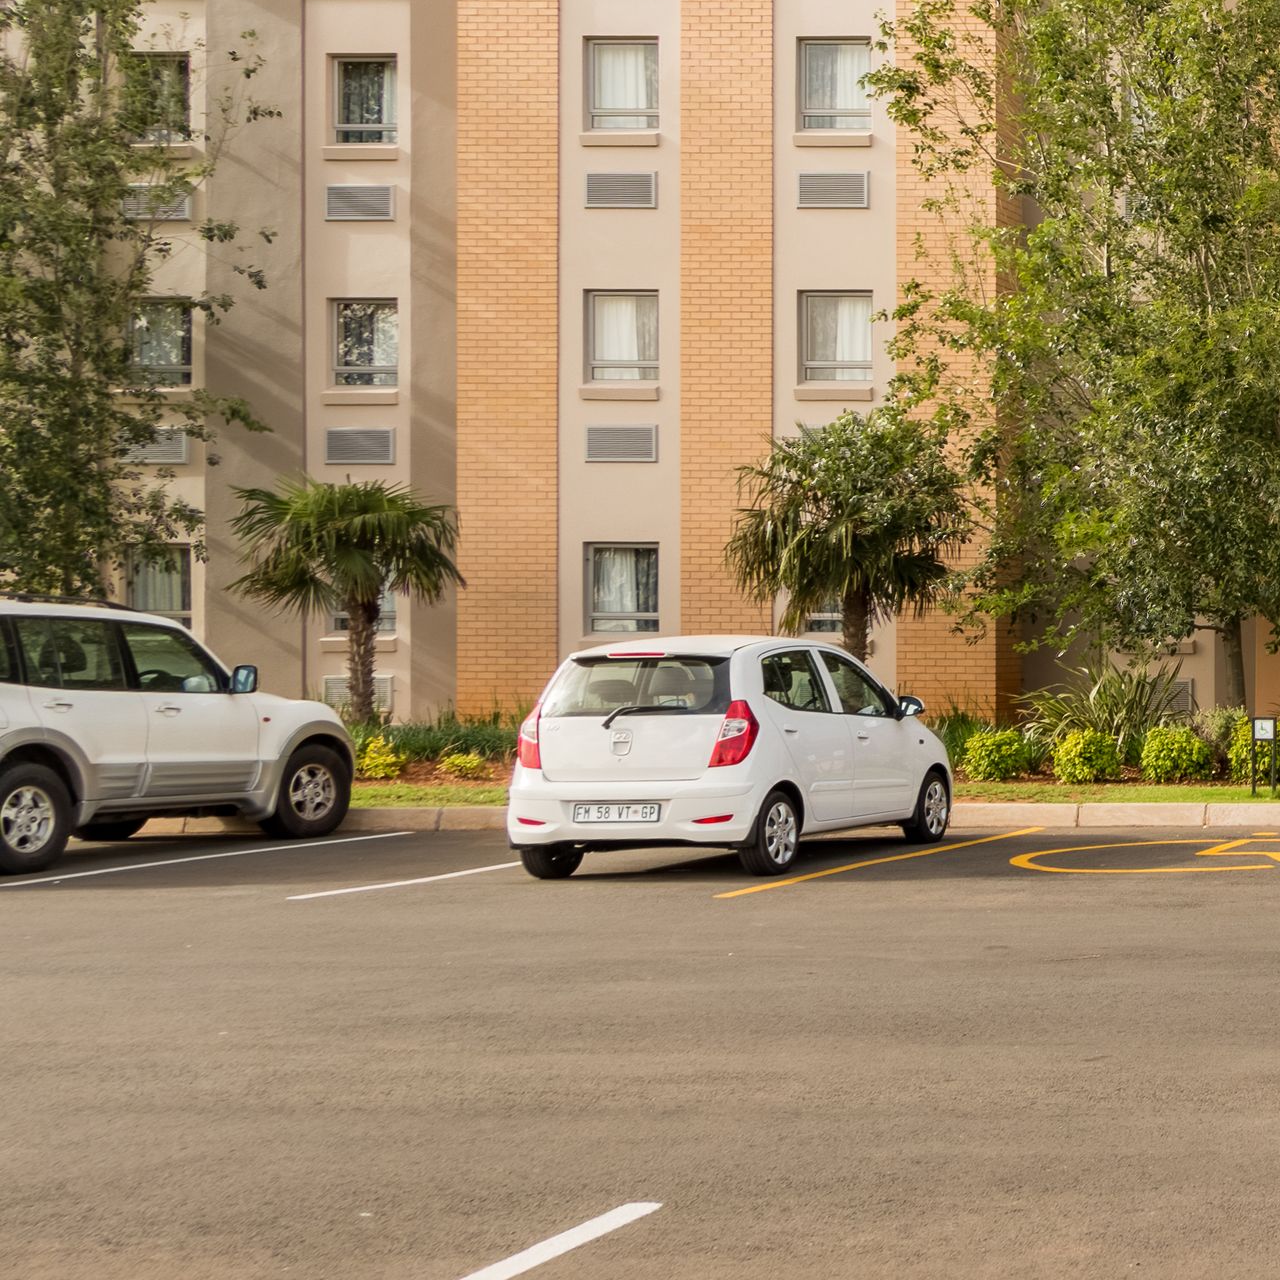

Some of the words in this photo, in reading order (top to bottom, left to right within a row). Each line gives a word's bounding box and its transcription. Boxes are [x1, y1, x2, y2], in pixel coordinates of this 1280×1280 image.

[576, 806, 591, 820] FM
[596, 806, 611, 820] 58
[617, 806, 632, 819] VT
[641, 806, 656, 820] GP
